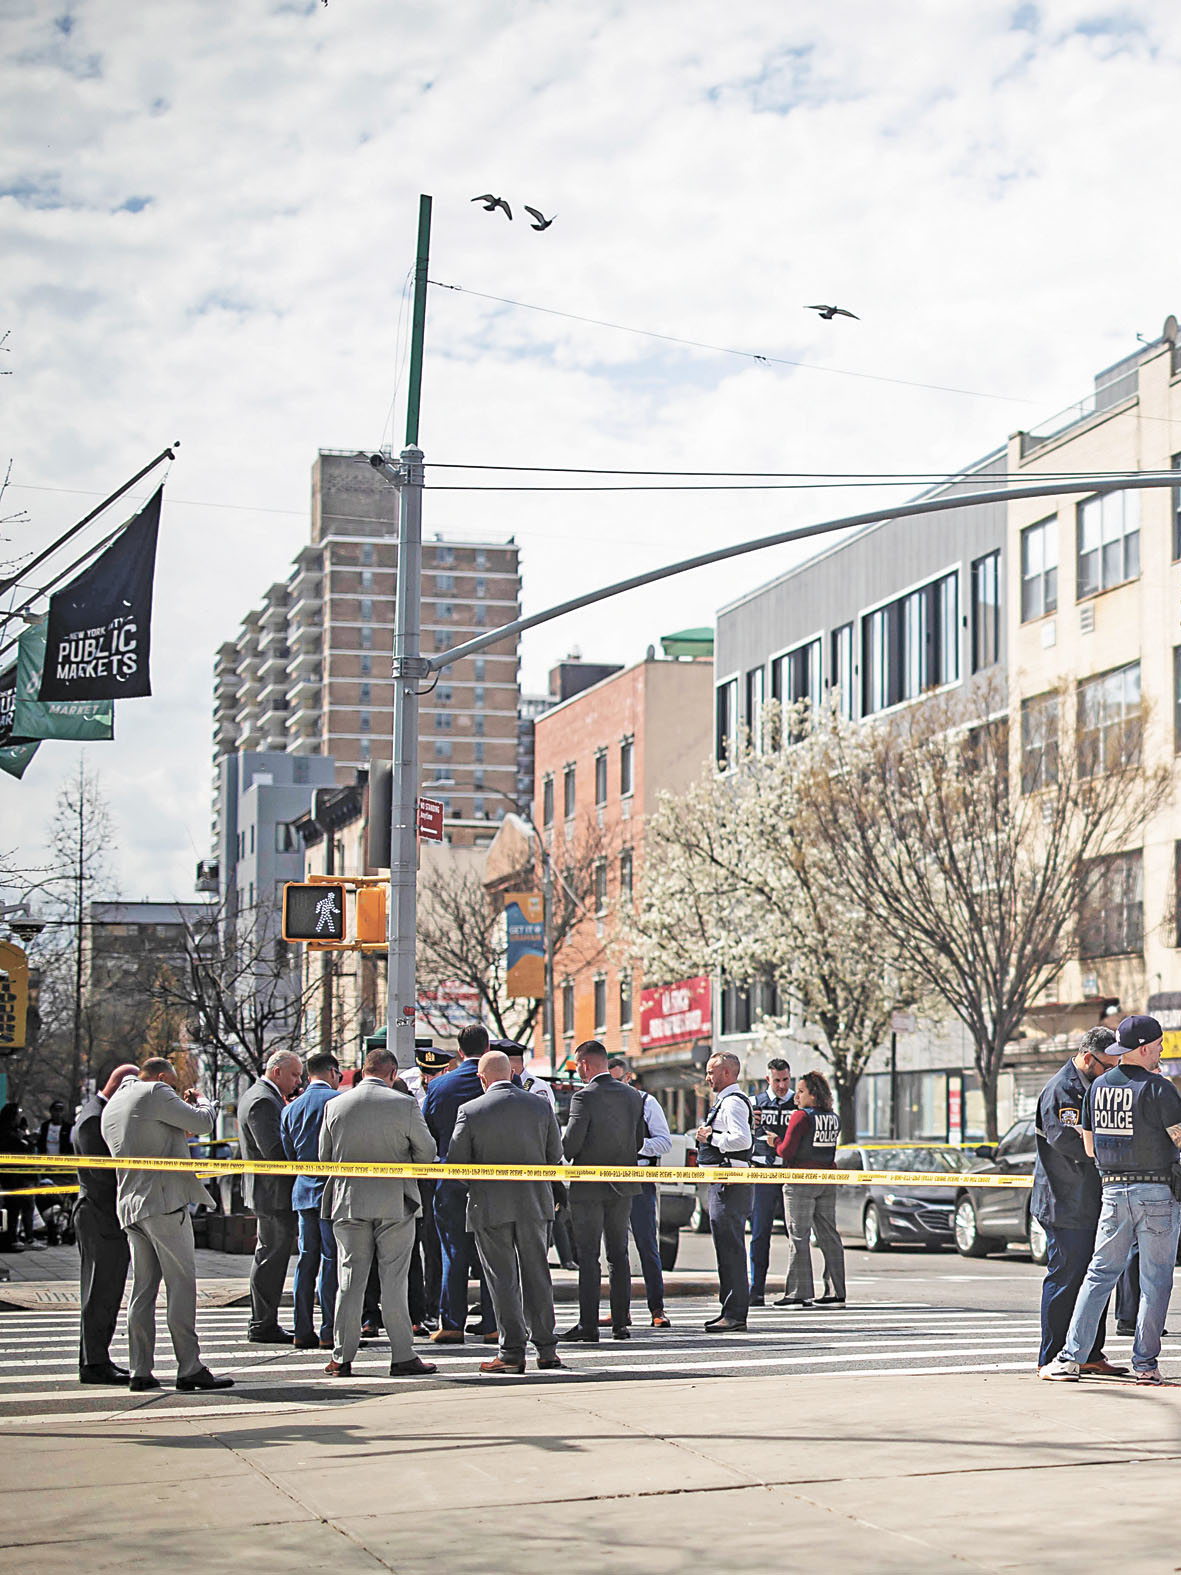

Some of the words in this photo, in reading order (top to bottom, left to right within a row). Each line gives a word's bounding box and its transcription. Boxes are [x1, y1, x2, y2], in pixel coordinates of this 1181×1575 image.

[87, 626, 106, 638] YORK
[58, 624, 137, 662] PUBLIC
[56, 652, 137, 680] MARKETS
[49, 704, 100, 715] MARKET
[1094, 1086, 1133, 1111] NYPD
[761, 1114, 791, 1125] POLIC
[815, 1115, 838, 1131] NYPD
[1094, 1110, 1133, 1128] POLICE
[814, 1131, 838, 1142] POLICE
